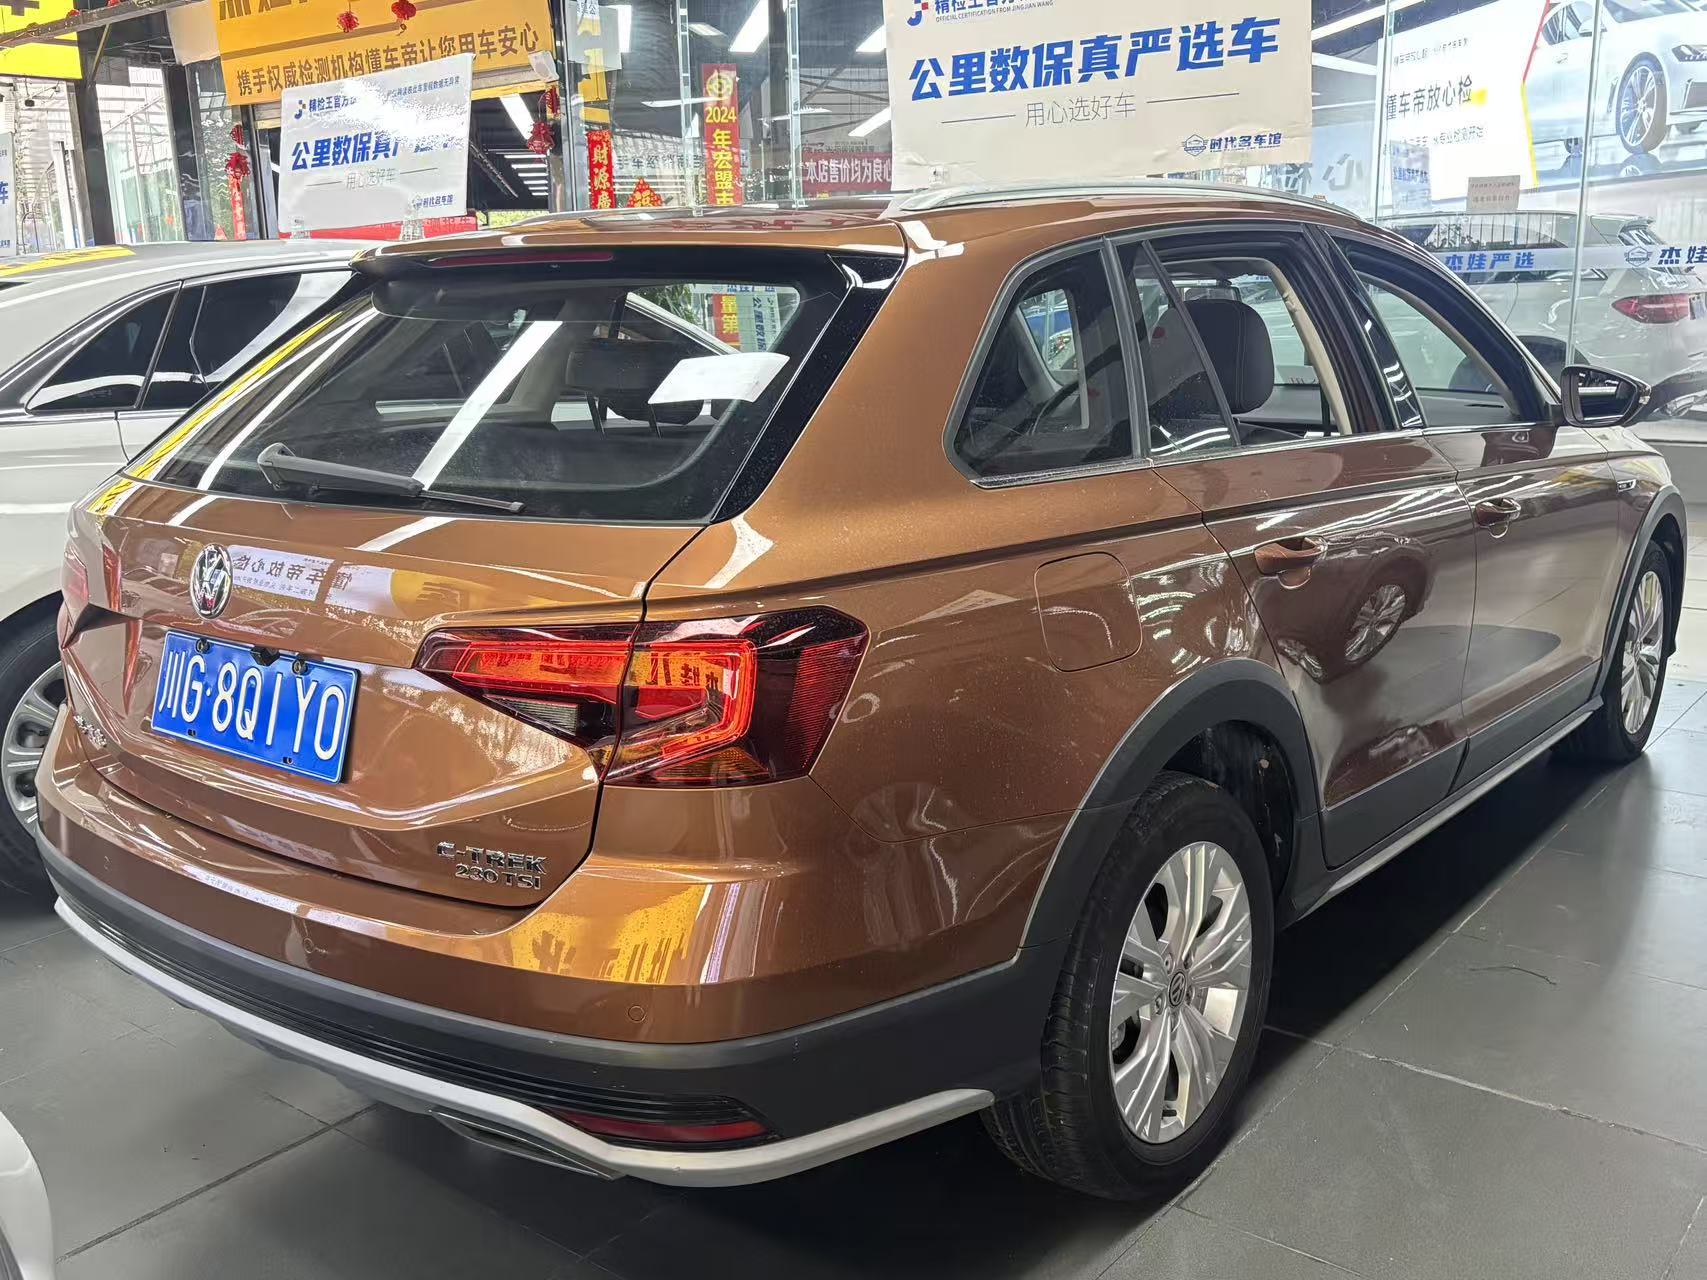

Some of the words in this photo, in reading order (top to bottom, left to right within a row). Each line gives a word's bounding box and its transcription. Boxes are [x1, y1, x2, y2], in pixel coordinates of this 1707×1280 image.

[909, 17, 1280, 101] 公里数保真严选车
[705, 106, 737, 124] 2024
[1025, 92, 1136, 128] 用心选好车
[1445, 251, 1535, 271] 杰娃严选
[1658, 245, 1707, 265] 杰娃
[437, 841, 547, 875] C-TREK
[455, 863, 499, 883] 230
[502, 871, 541, 890] TSI
